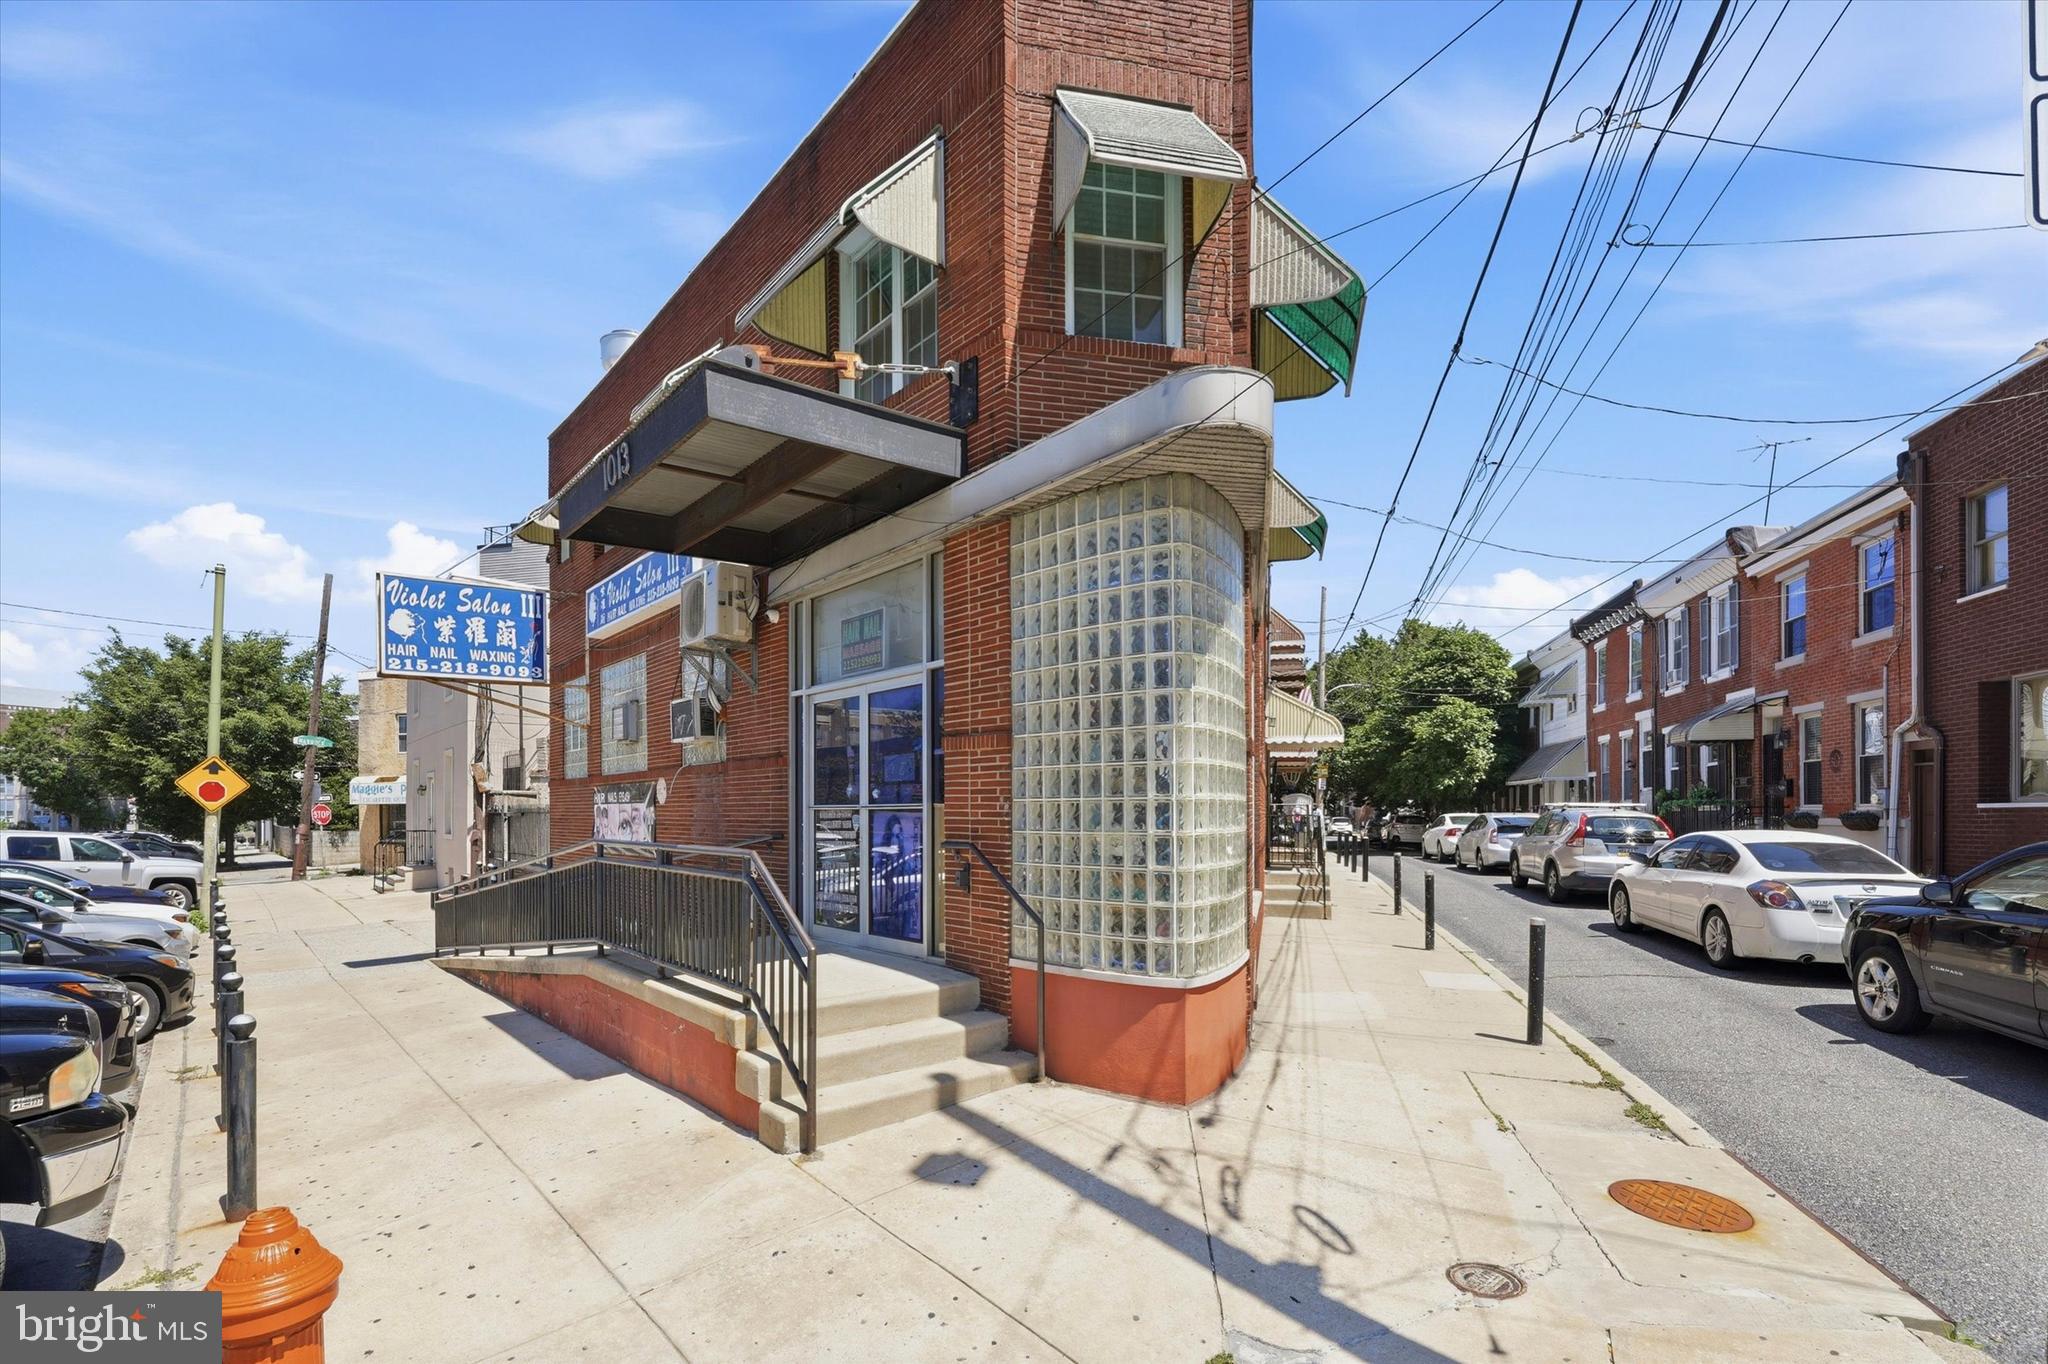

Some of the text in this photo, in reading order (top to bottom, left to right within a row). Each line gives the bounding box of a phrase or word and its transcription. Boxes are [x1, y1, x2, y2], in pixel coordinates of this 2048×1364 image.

[603, 442, 631, 491] 1013
[386, 578, 542, 619] Violet Salon III
[606, 577, 631, 608] Violet
[634, 560, 662, 594] Salon
[387, 643, 516, 664] HAIR NAIL WAXING
[313, 810, 331, 819] STOP
[1930, 964, 1964, 977] COMPASS
